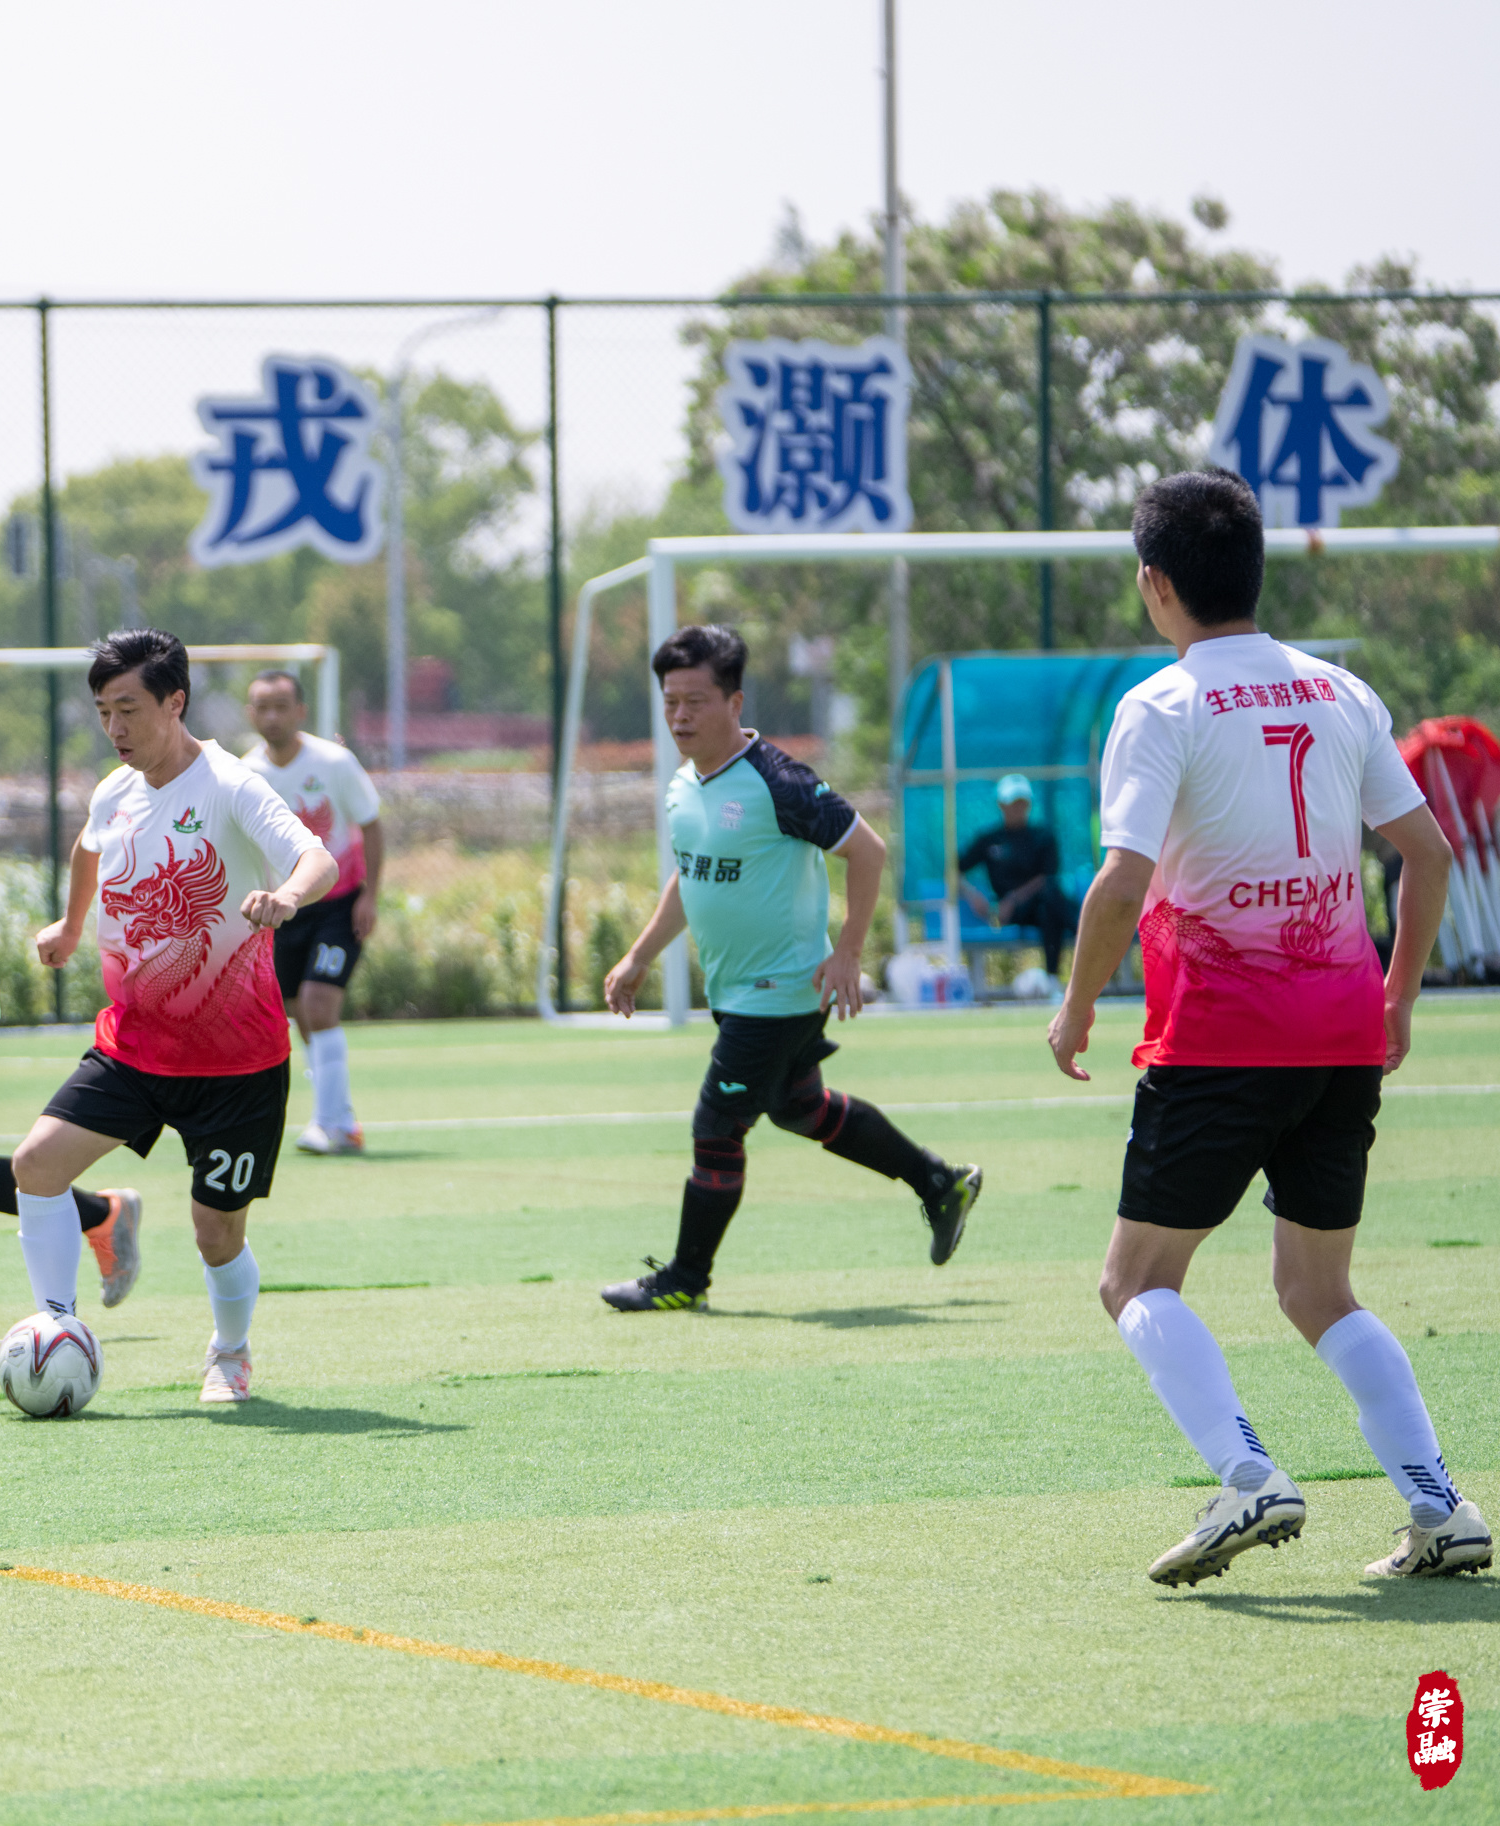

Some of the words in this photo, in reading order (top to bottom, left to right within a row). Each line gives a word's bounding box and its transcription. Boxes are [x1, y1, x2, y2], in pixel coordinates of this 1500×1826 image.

[1205, 678, 1336, 716] 生态旅游集团
[1261, 722, 1315, 858] 7
[314, 942, 347, 977] 10
[204, 1149, 255, 1193] 20
